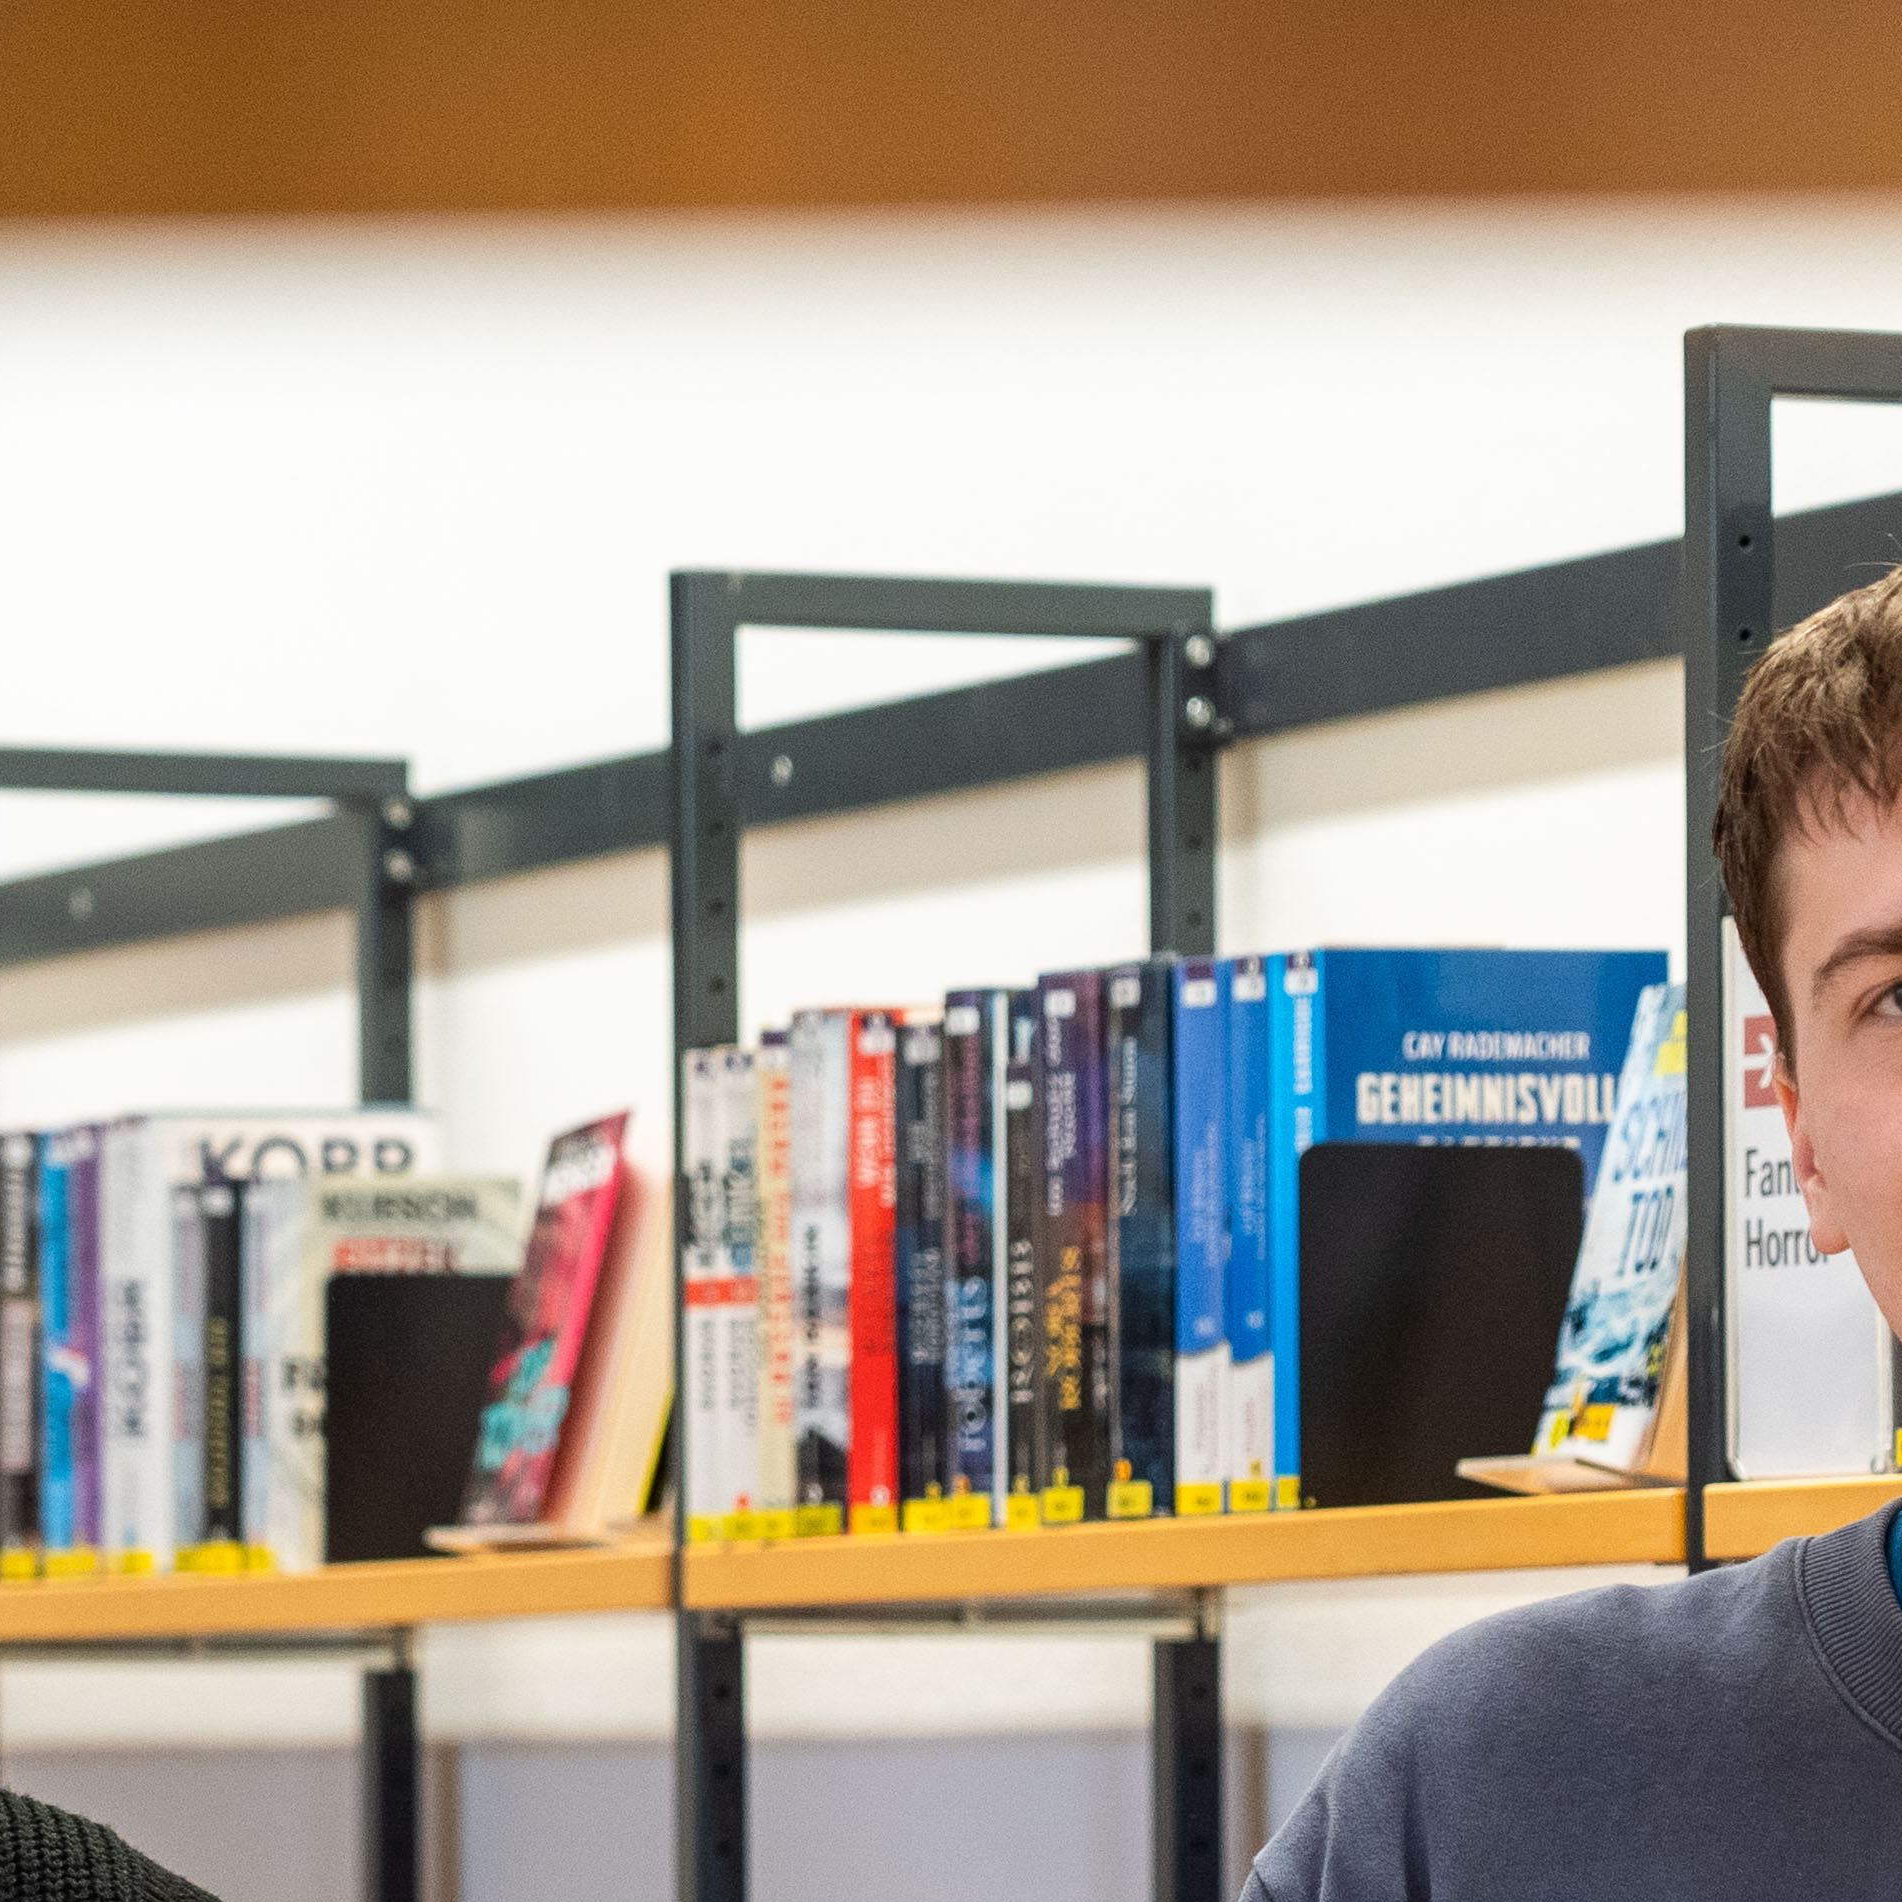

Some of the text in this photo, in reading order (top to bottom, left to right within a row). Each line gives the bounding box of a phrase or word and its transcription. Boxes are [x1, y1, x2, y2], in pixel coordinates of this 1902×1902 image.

[1402, 1031, 1590, 1060] CAY RADEMACHER
[1356, 1071, 1616, 1126] GEHEIMNISVOLL
